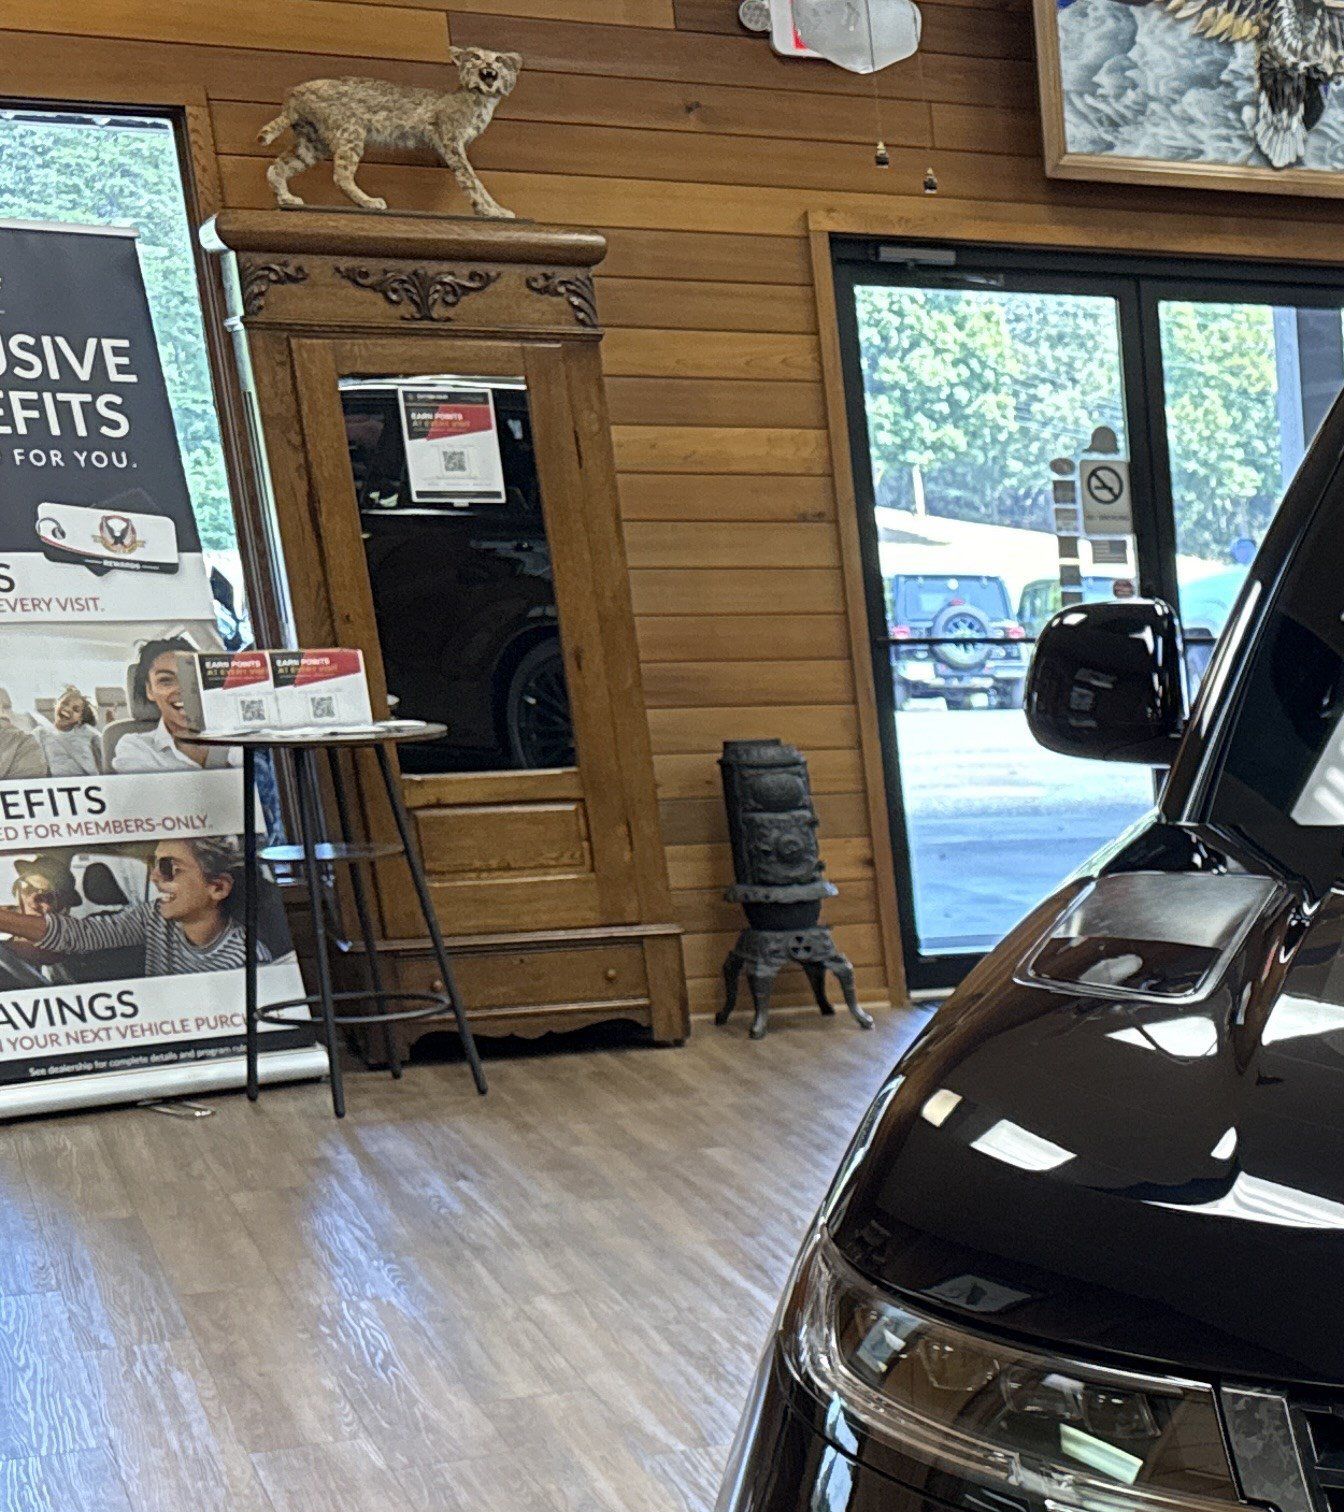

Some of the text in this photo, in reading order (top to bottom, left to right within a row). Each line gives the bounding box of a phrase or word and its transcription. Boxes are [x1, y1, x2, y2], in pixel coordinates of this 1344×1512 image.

[0, 333, 138, 383] SIVE
[13, 448, 138, 469] FOR YOU.
[24, 823, 61, 841] FOR
[7, 1033, 62, 1052] YOUR
[65, 1027, 112, 1046] NEXT
[115, 1017, 192, 1040] VEHICLE
[195, 1012, 248, 1031] PURC
